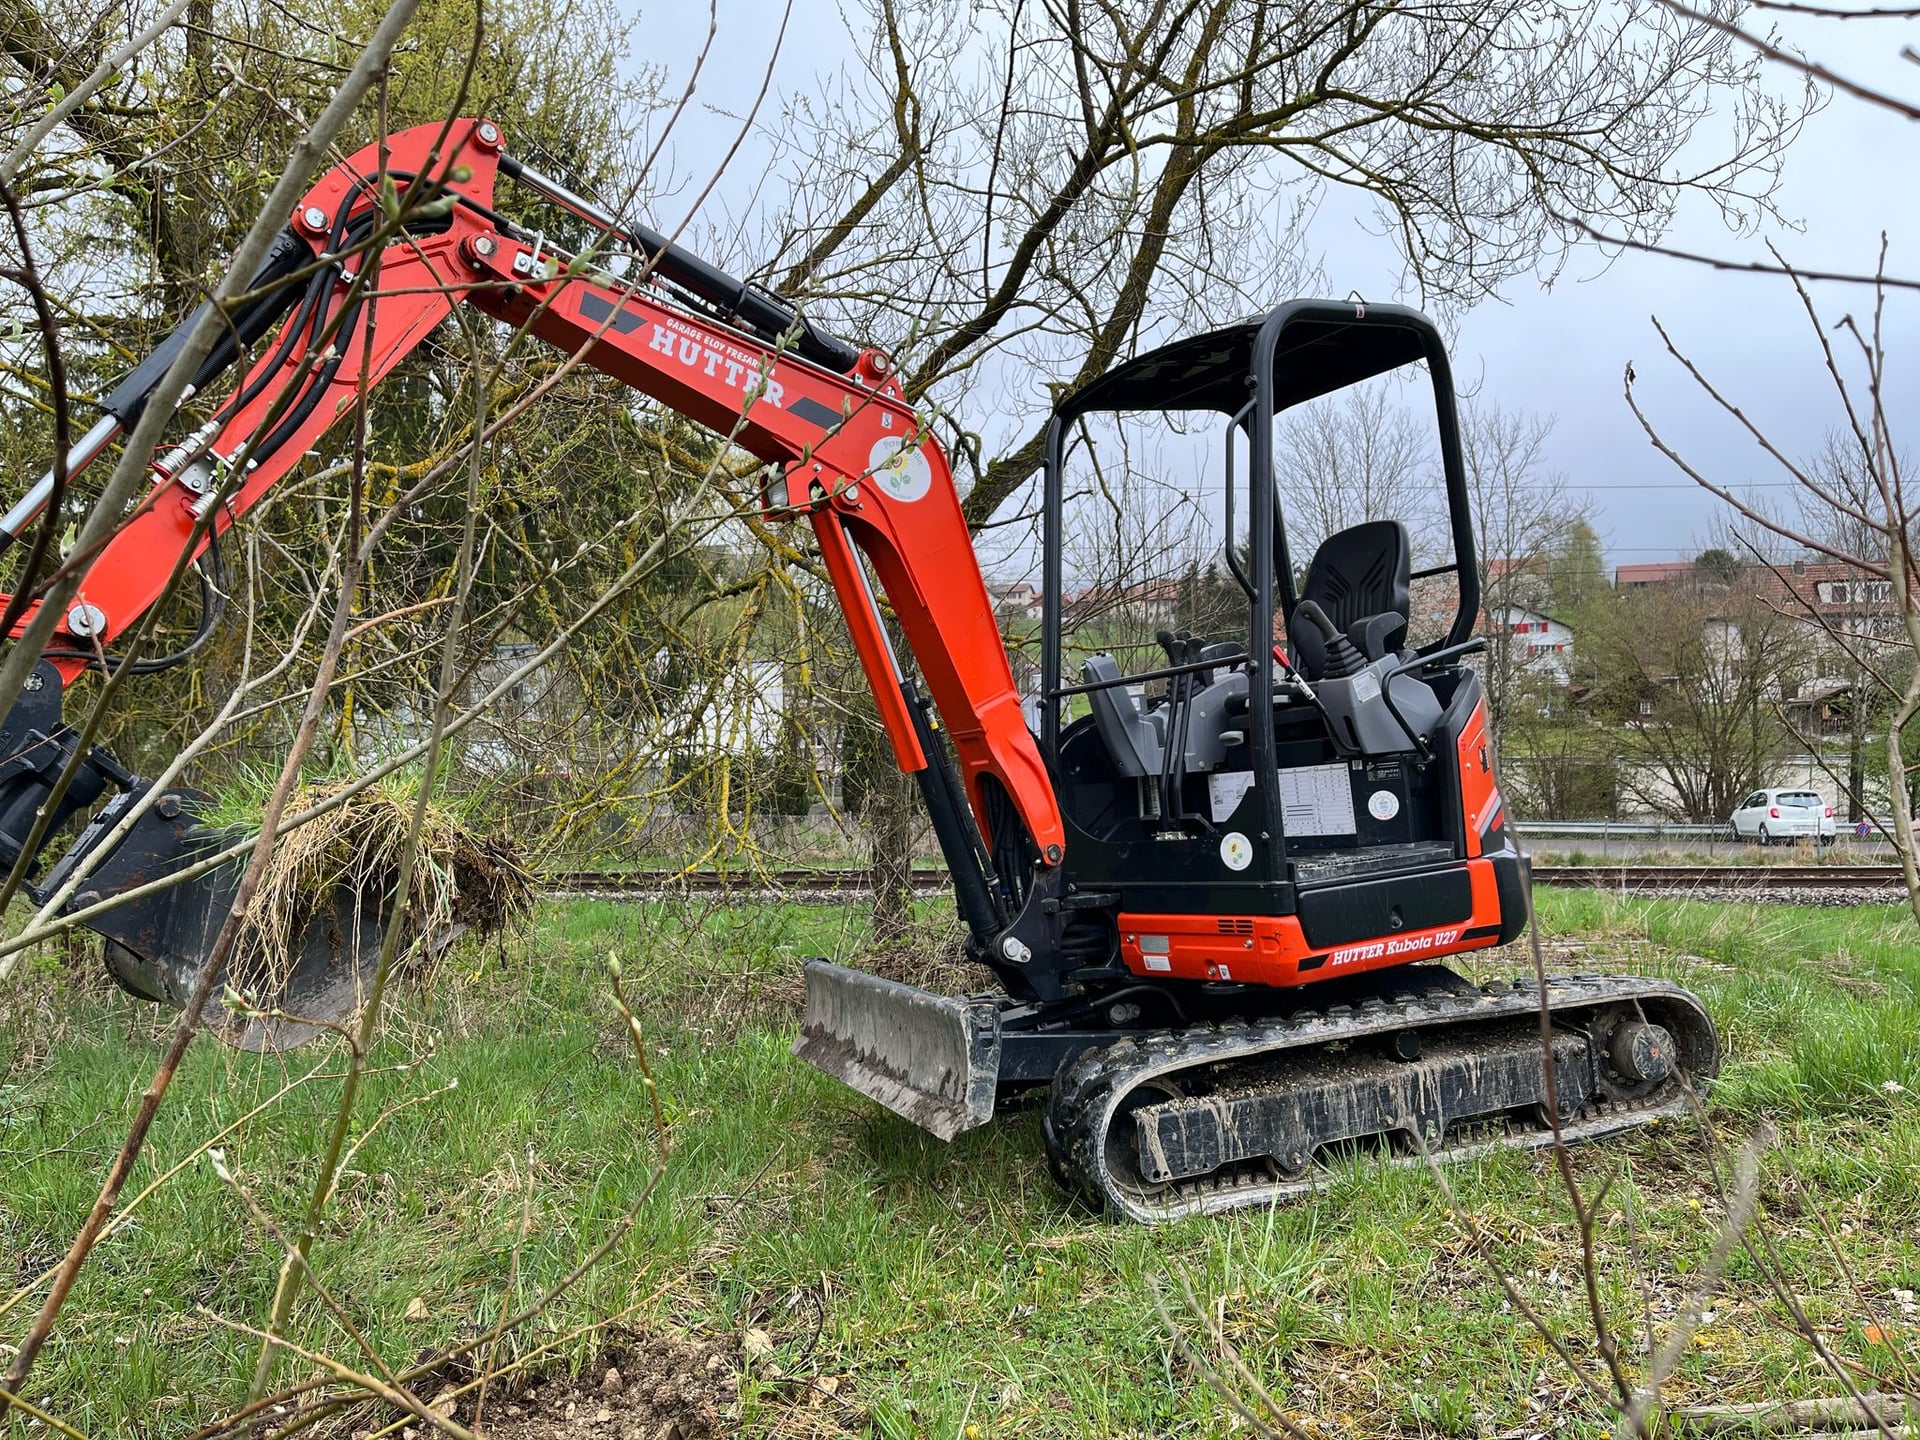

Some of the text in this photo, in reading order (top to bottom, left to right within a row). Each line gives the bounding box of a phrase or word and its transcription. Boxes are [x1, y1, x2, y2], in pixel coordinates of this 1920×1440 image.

[649, 323, 784, 409] HUTTER
[666, 318, 703, 341] GARAGE
[703, 336, 726, 351] ELOY
[726, 346, 765, 370] FRESAR
[1332, 930, 1458, 966] HUTTER Kubota U27
